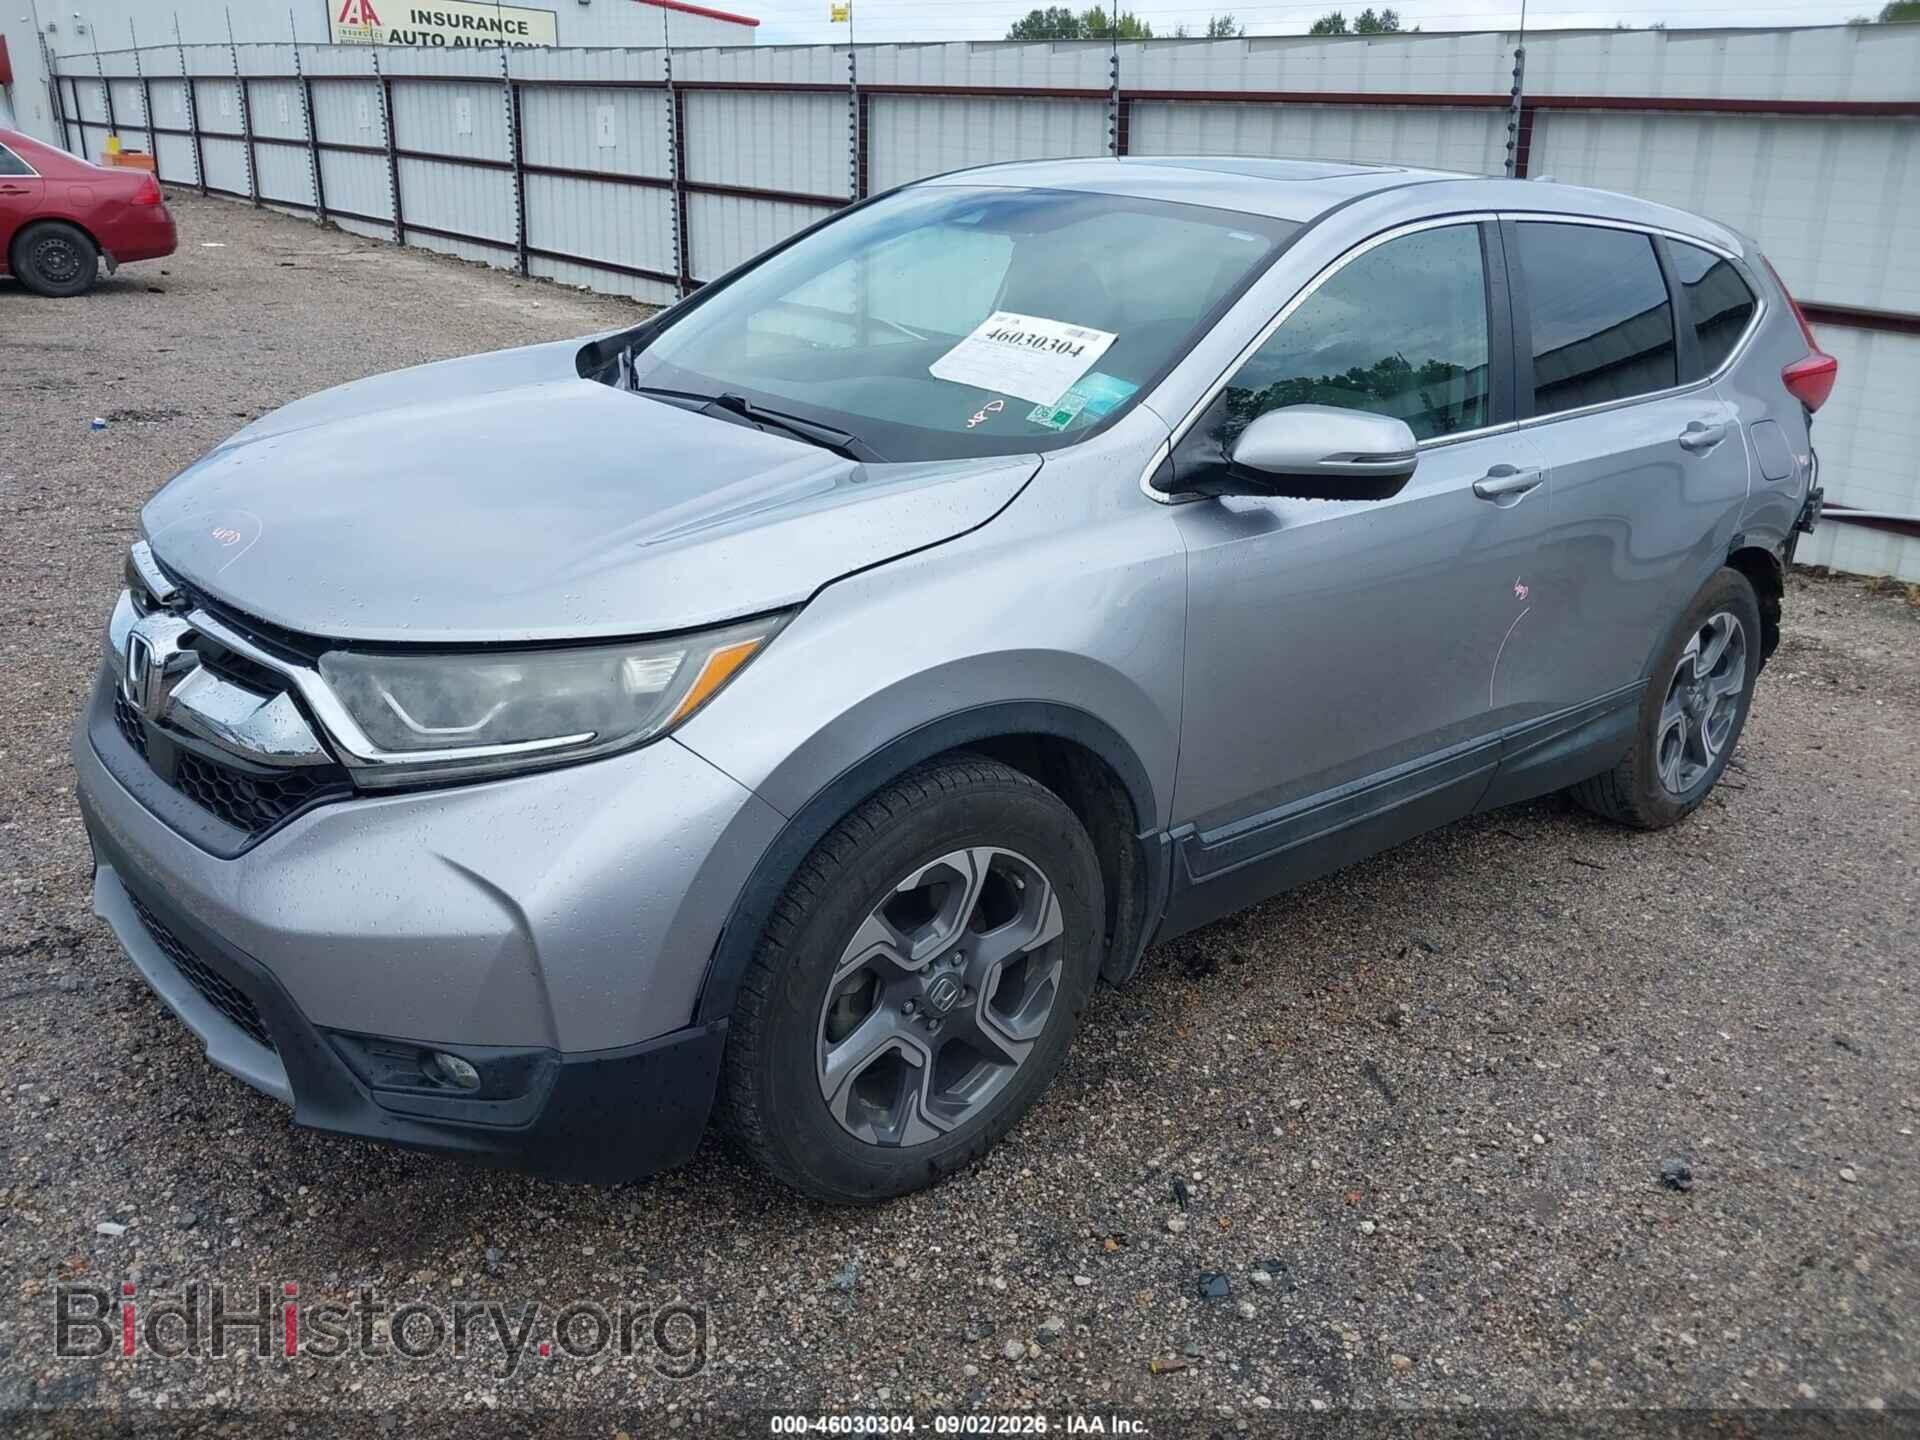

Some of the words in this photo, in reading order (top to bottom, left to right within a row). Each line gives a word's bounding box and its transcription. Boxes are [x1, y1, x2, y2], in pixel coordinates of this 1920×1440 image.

[410, 9, 529, 36] INSURANCE
[388, 28, 445, 47] AUTO
[986, 327, 1085, 358] 46030304
